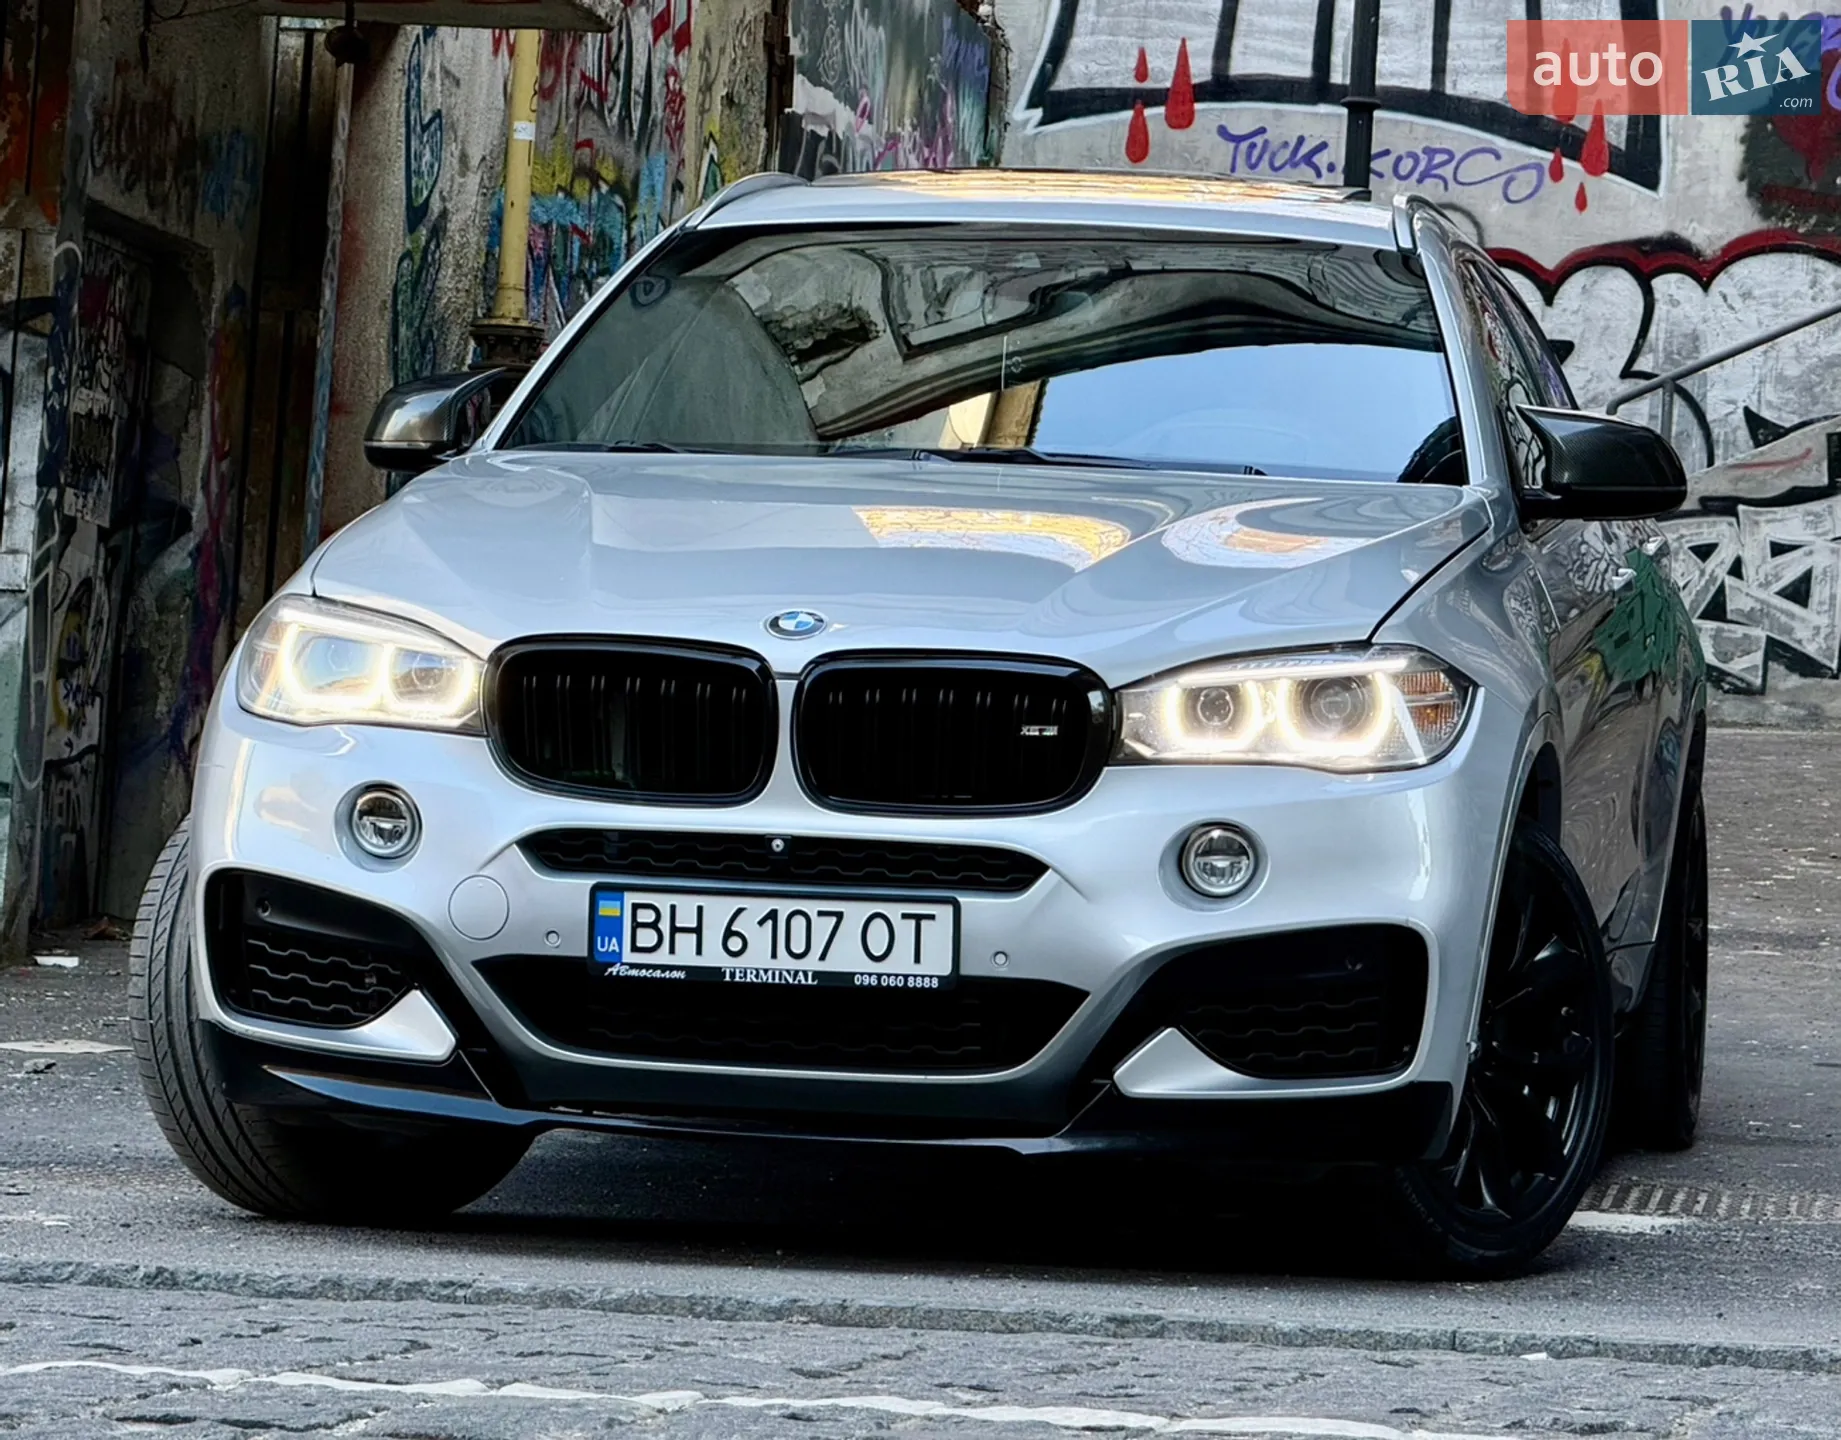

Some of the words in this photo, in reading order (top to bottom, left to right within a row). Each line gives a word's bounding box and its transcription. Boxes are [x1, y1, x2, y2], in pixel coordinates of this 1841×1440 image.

[630, 901, 704, 956] BH
[721, 906, 845, 962] 6107
[860, 911, 936, 964] OT
[596, 935, 620, 953] UA
[603, 962, 687, 980] Автосалон
[721, 967, 818, 985] TERMINAL
[854, 973, 877, 986] 096
[880, 975, 904, 987] 060
[907, 975, 939, 988] 8888
